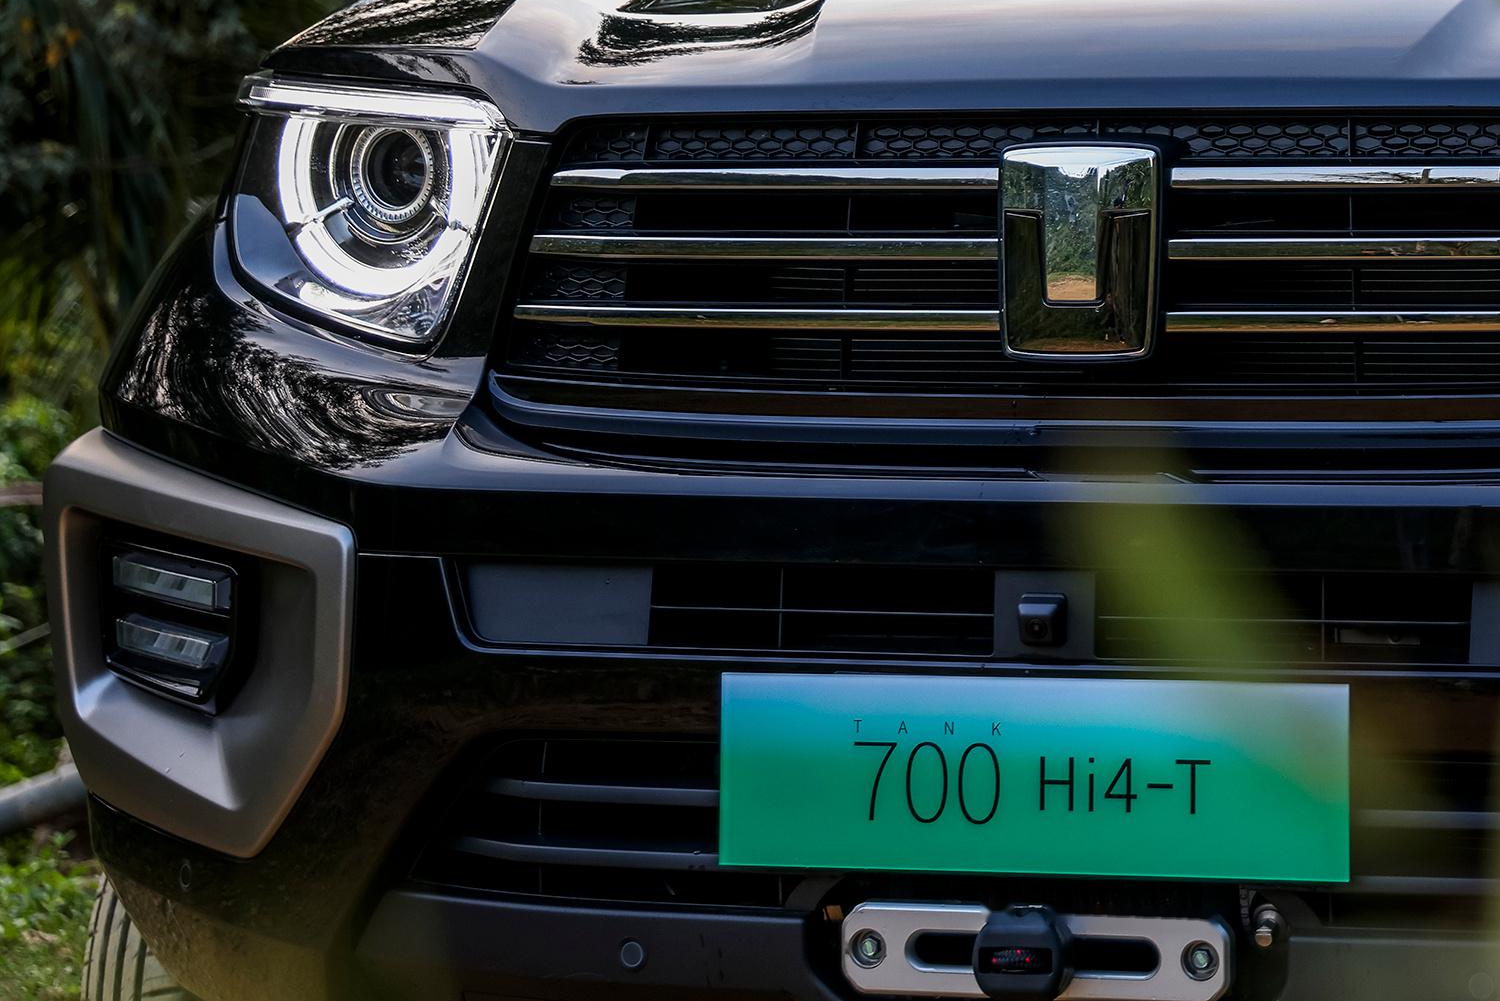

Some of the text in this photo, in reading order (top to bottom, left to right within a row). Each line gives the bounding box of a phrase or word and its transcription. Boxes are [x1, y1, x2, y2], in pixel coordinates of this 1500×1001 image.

[854, 719, 1002, 736] TANK
[853, 741, 1212, 825] 700 Hi4-T
